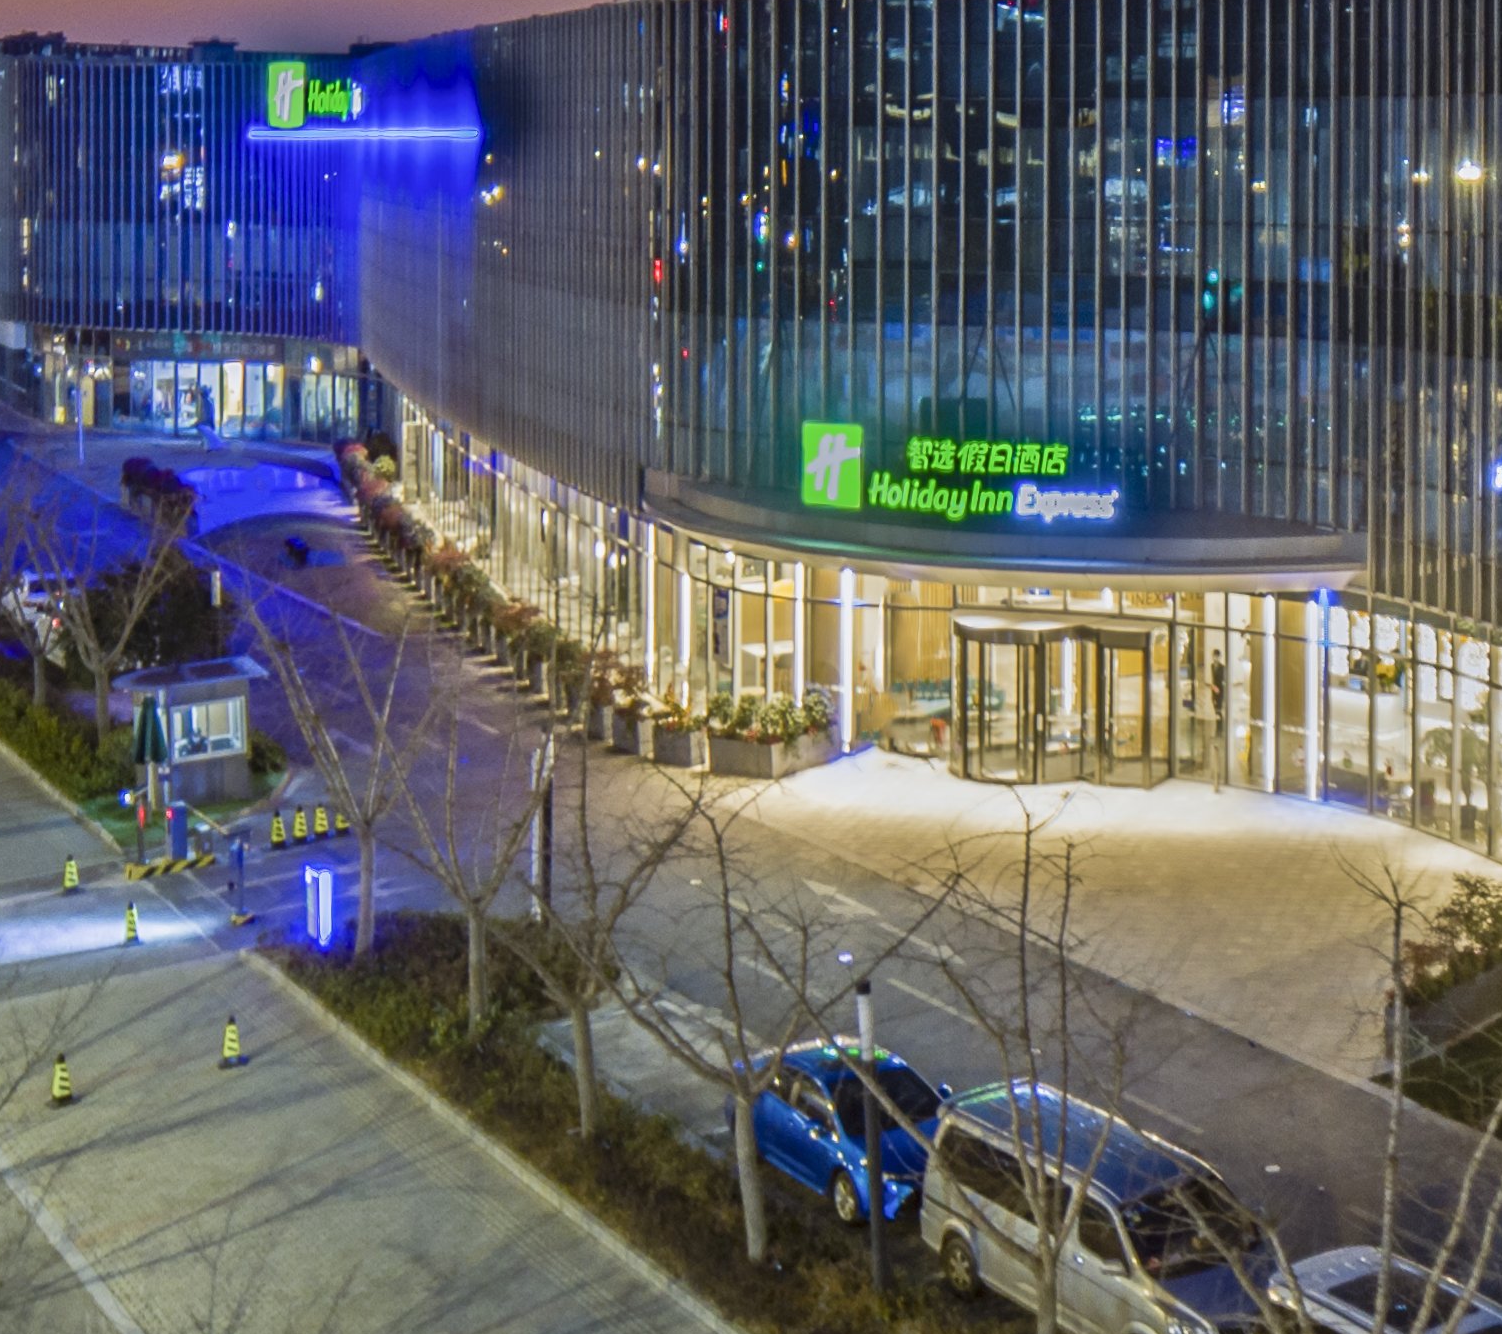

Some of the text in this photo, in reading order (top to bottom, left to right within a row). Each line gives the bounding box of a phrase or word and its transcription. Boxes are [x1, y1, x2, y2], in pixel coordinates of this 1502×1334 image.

[907, 436, 1069, 475] 智选假日酒店
[868, 471, 968, 520] Holiday
[970, 479, 1014, 513] Inn
